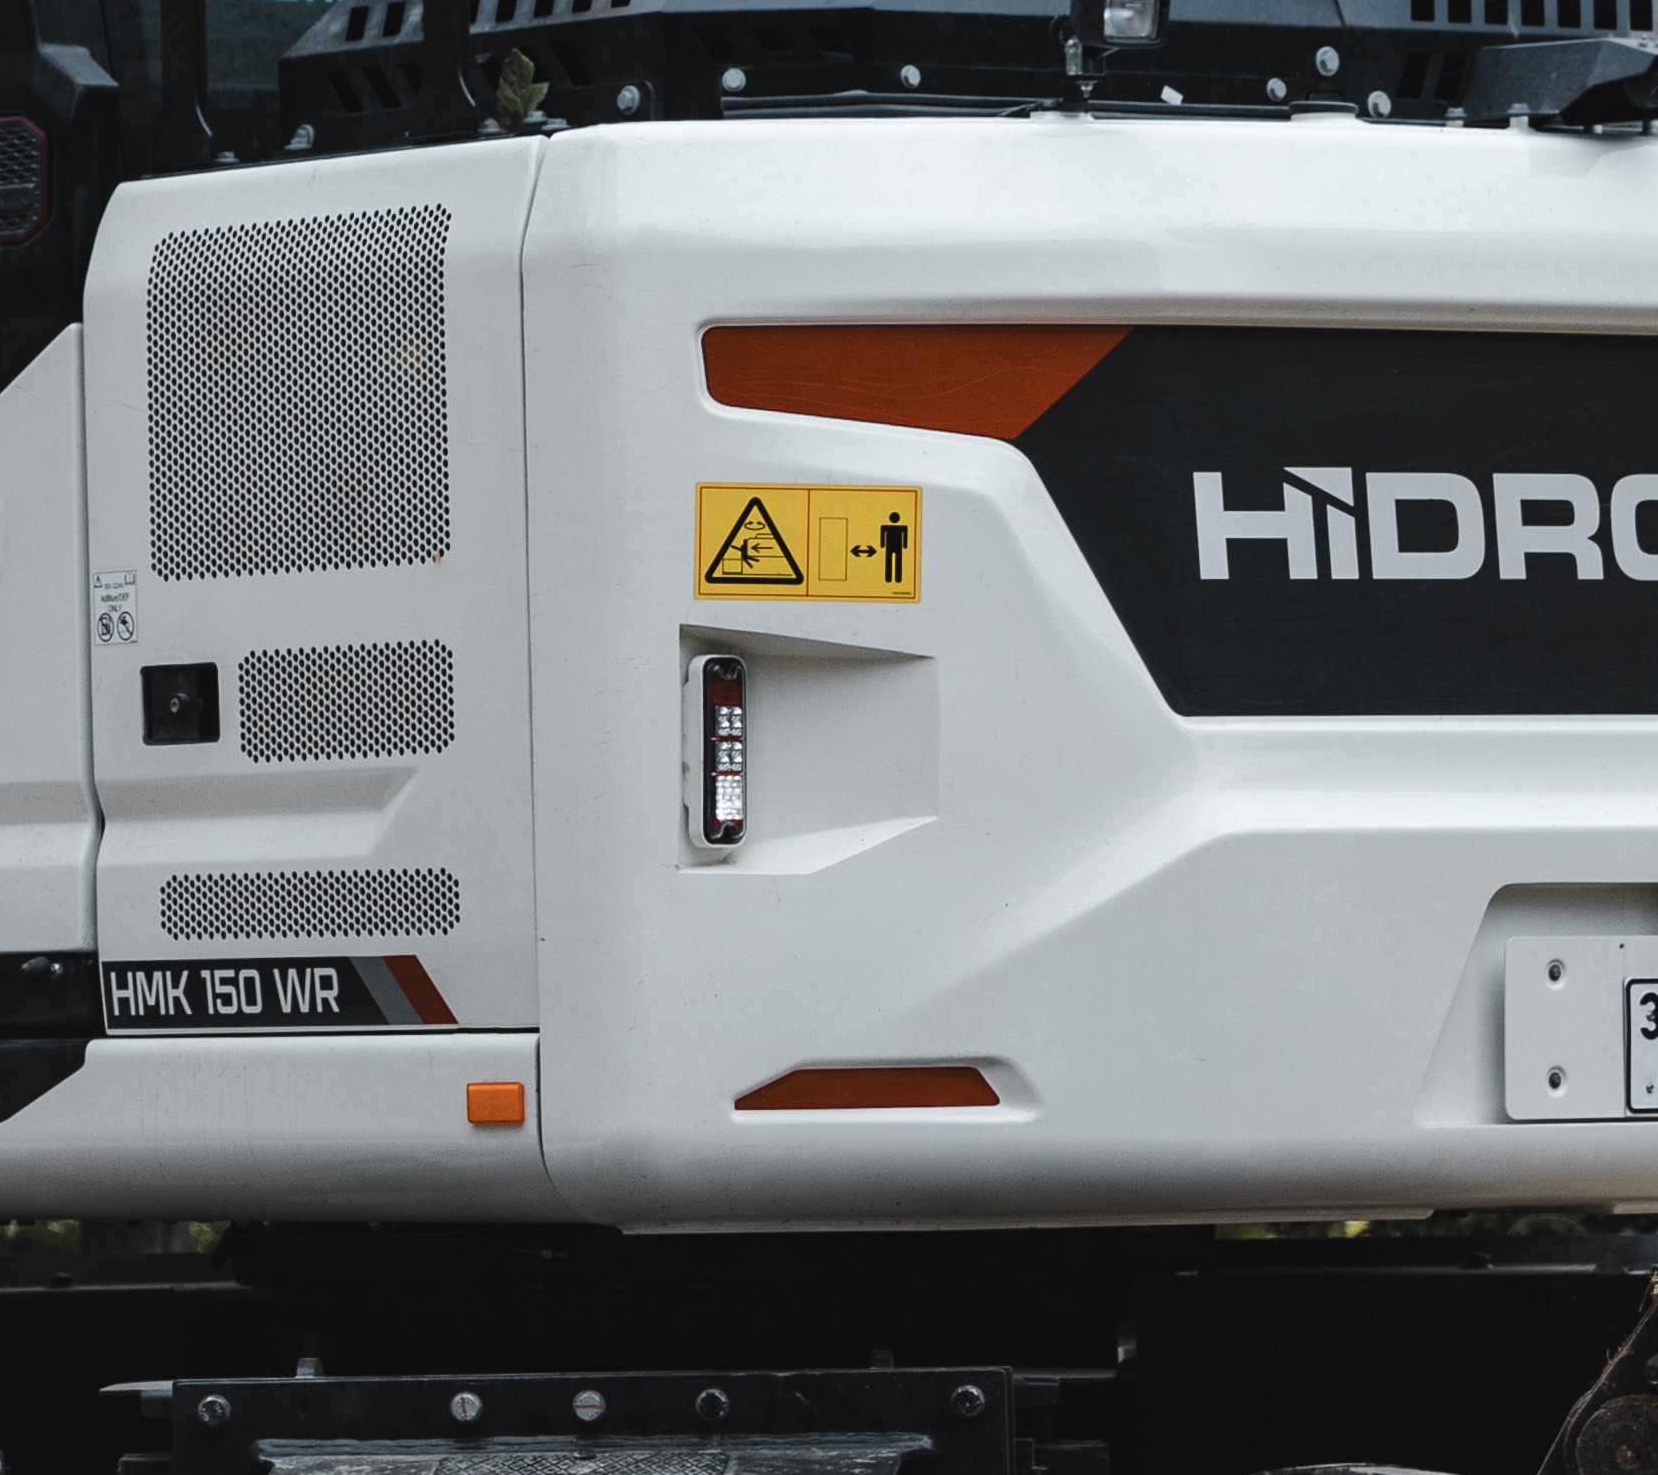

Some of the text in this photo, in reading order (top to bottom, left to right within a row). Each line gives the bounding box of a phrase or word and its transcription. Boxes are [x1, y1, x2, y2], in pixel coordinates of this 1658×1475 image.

[110, 968, 339, 1016] HMK 150 WR
